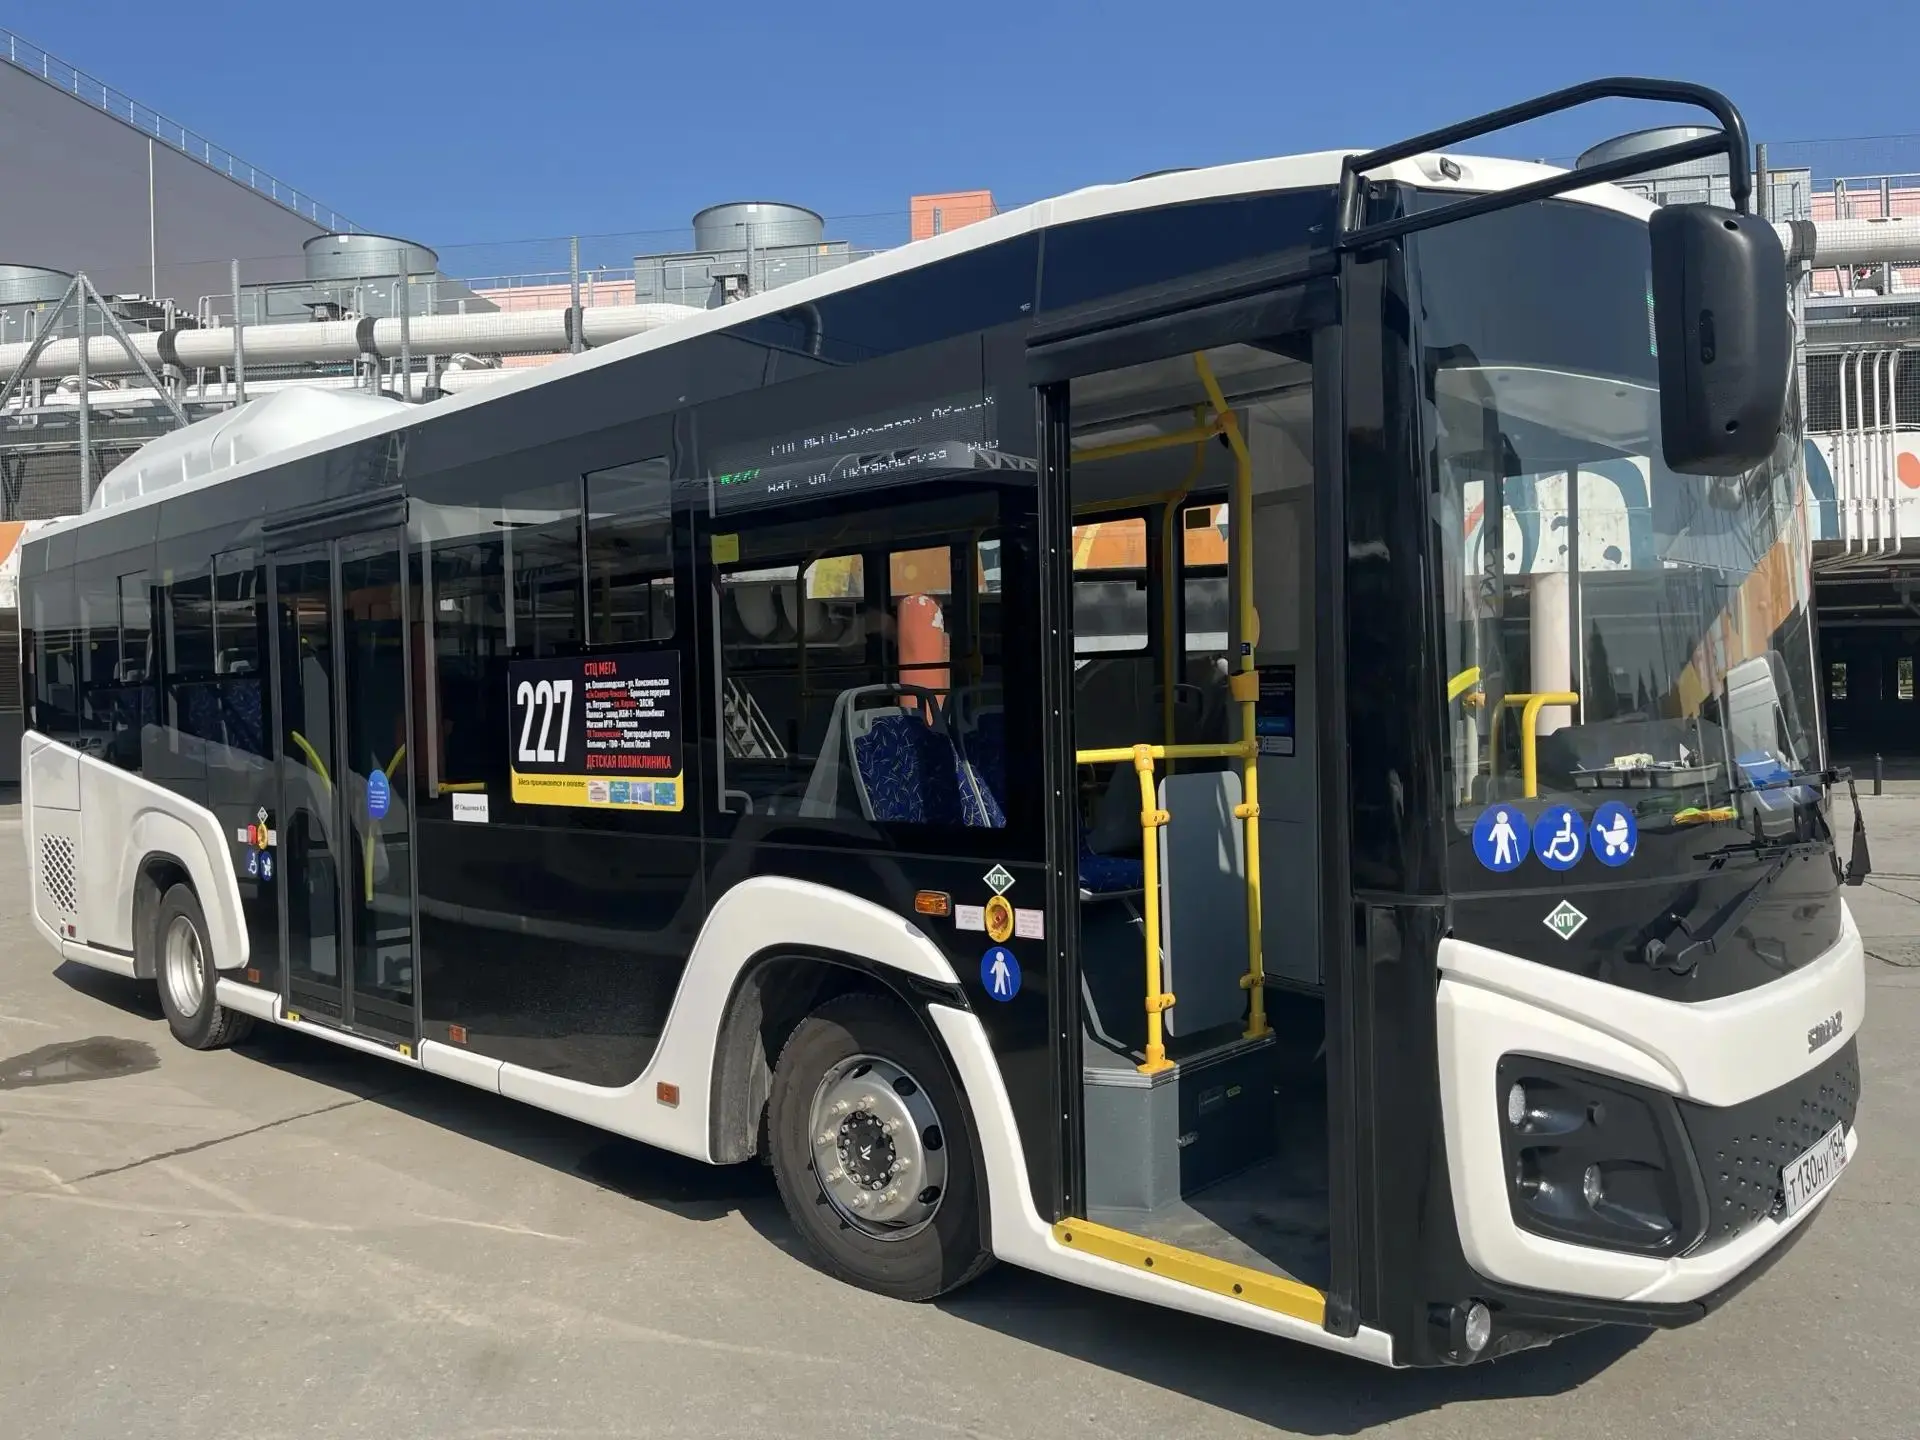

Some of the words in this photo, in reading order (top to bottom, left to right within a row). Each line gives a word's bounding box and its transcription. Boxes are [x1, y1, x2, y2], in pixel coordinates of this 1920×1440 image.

[585, 662, 598, 678] СТЦ
[599, 661, 616, 675] МЕГА
[516, 679, 573, 763] 227
[587, 754, 617, 770] ДЕТСКАЯ
[618, 754, 672, 769] ПОЛИКЛИНИКА
[989, 873, 1008, 886] КПГ
[1553, 912, 1577, 928] КПГ
